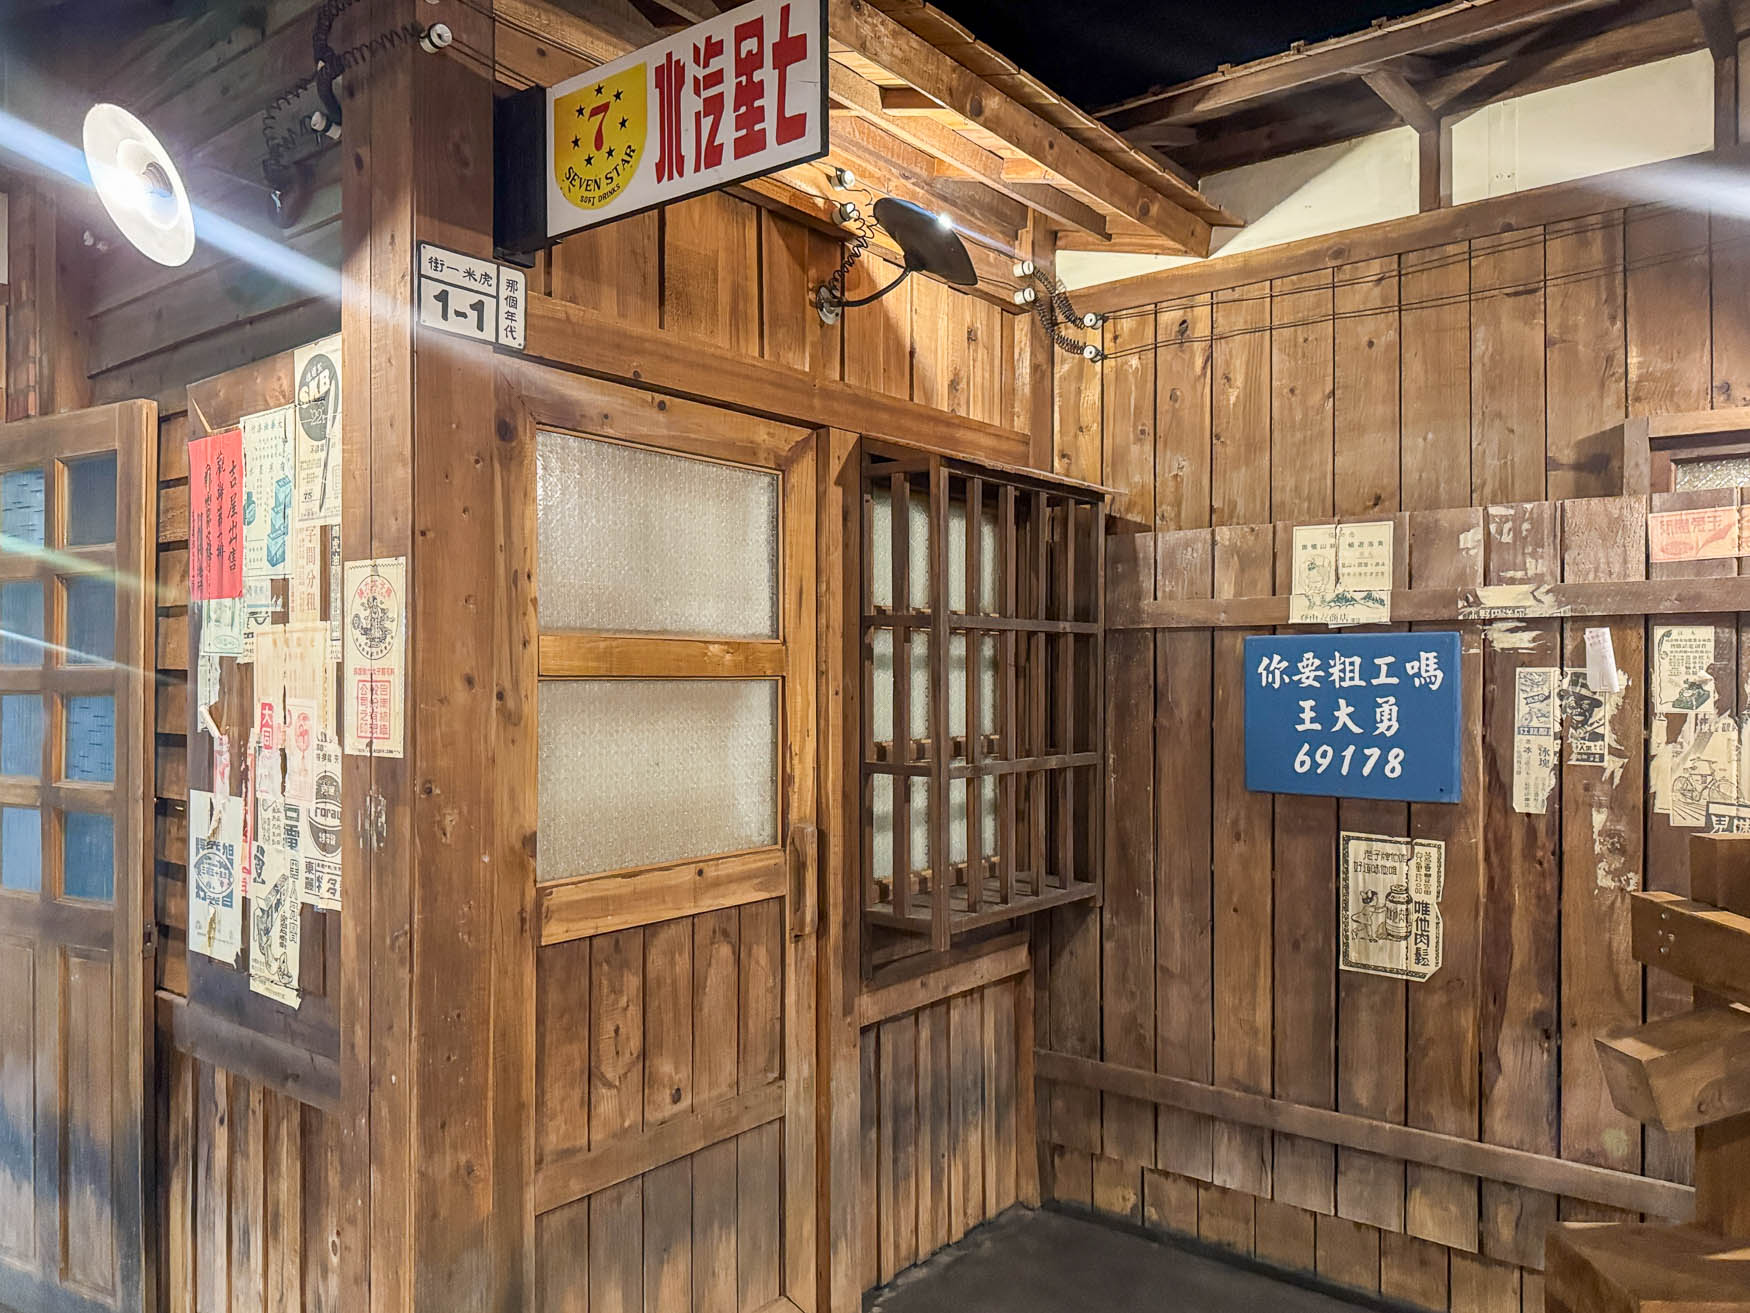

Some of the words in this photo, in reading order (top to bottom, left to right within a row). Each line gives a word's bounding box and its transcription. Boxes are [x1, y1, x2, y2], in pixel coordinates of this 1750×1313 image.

[588, 101, 611, 152] 7
[564, 166, 602, 193] SEVEN
[605, 144, 637, 186] STAR
[580, 195, 596, 206] SOFT
[598, 183, 621, 203] DRINKS
[433, 289, 485, 333] 1-1
[504, 279, 519, 342] 那個年代
[1257, 651, 1444, 691] 你要粗工嗎
[262, 705, 273, 748] 大同
[1294, 696, 1400, 737] 王大勇
[1294, 742, 1406, 778] 69178
[1414, 900, 1431, 967] 唯他肉鬆
